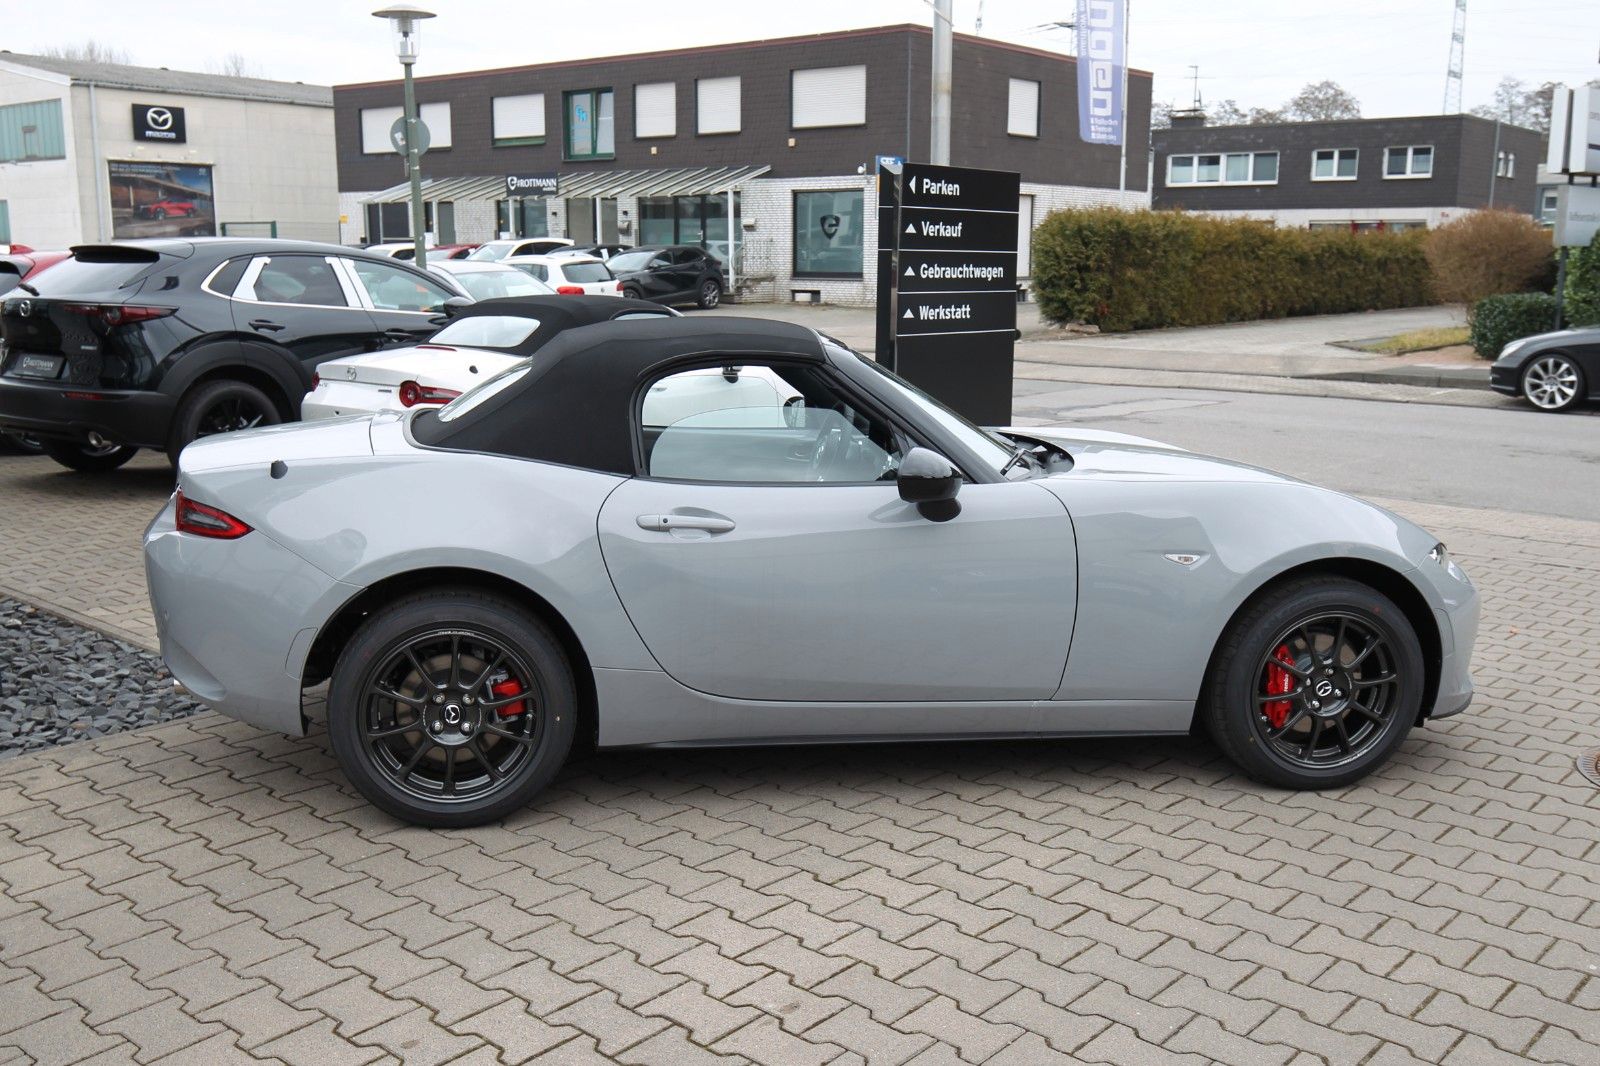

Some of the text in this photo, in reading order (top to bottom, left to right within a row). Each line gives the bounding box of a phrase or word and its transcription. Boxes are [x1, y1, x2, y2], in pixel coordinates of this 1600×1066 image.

[923, 178, 960, 196] Parken
[921, 221, 962, 237] Verkauf
[920, 263, 1004, 281] Gebrauchtwagen
[919, 304, 971, 320] Werkstatt
